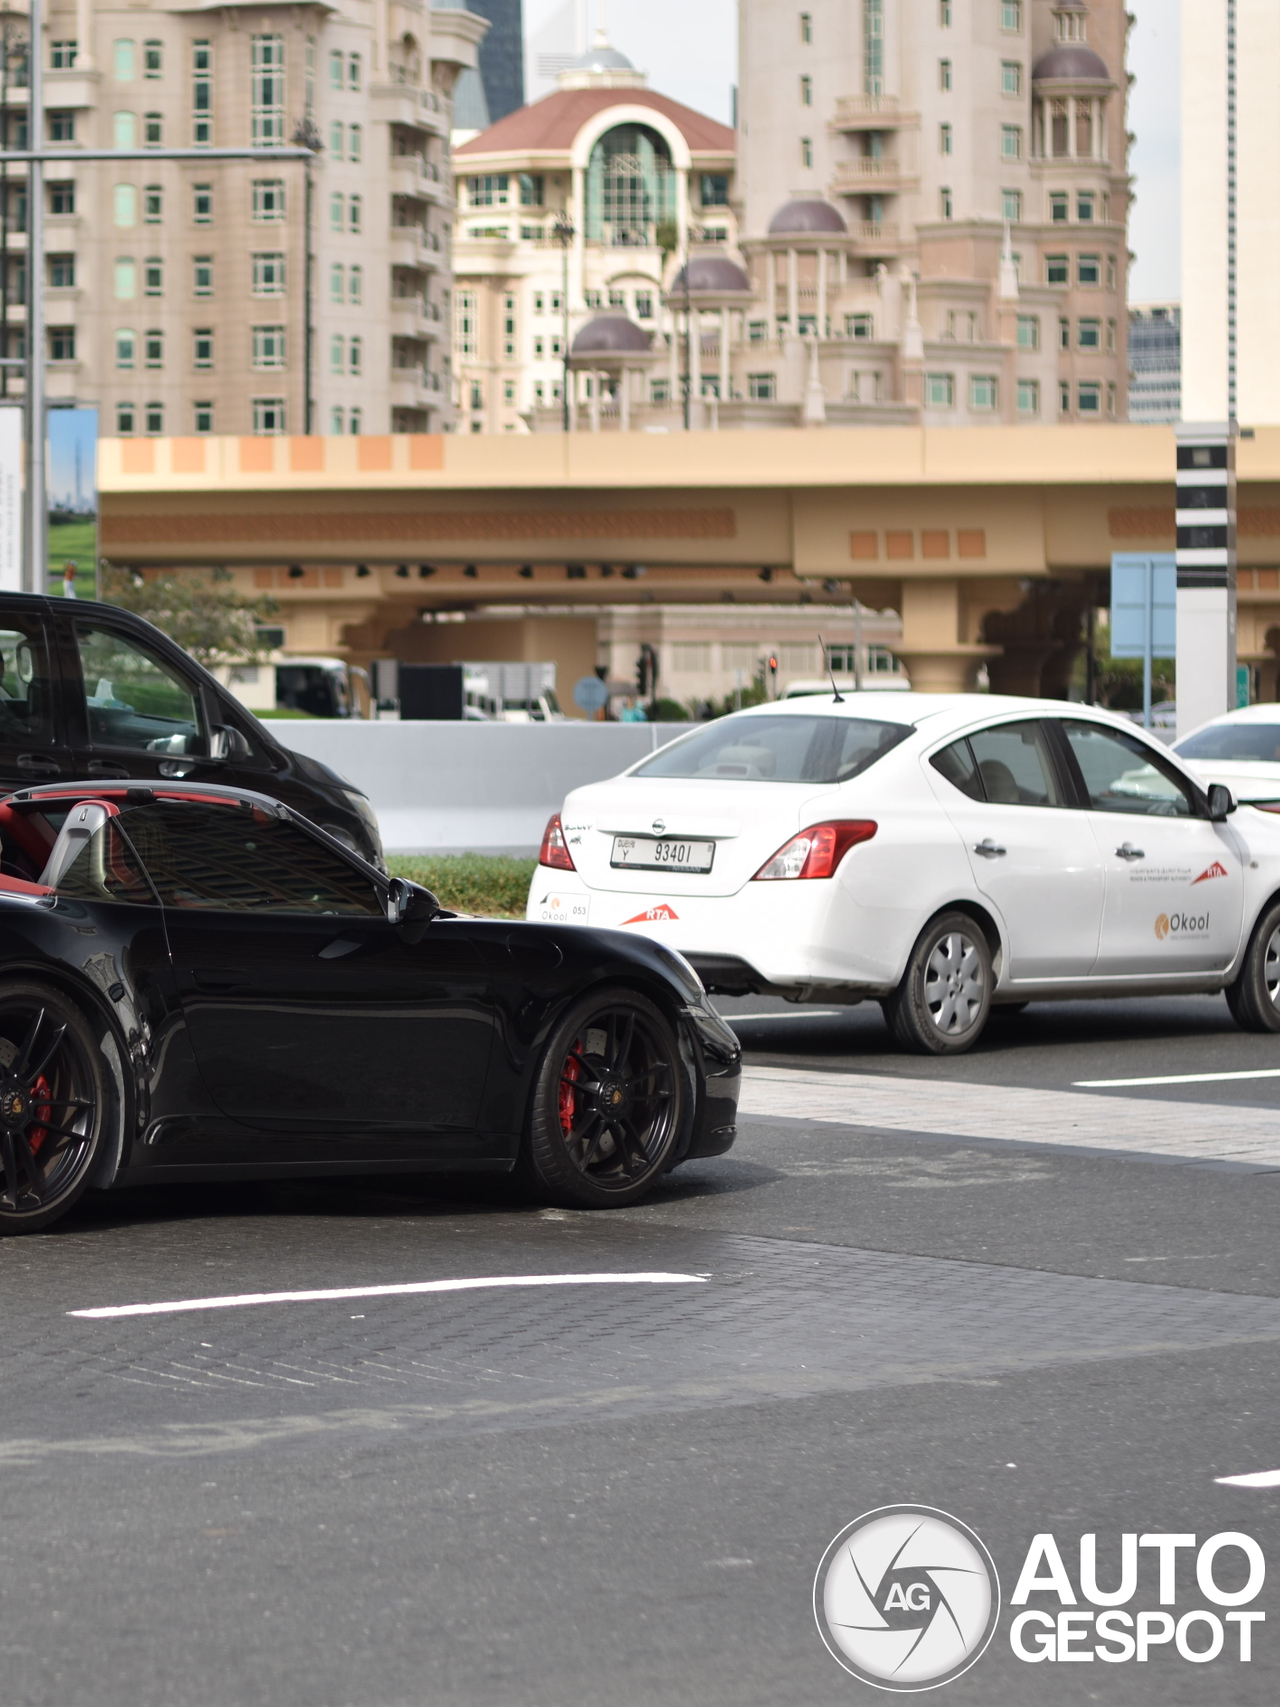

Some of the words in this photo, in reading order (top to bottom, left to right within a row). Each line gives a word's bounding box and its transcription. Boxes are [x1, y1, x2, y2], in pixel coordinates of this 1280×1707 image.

[622, 850, 629, 860] Y
[655, 843, 692, 864] 93401
[1207, 866, 1222, 878] RTA
[541, 910, 568, 921] Okool
[572, 906, 586, 915] 053
[646, 908, 670, 920] RTA
[1170, 912, 1210, 932] Okool
